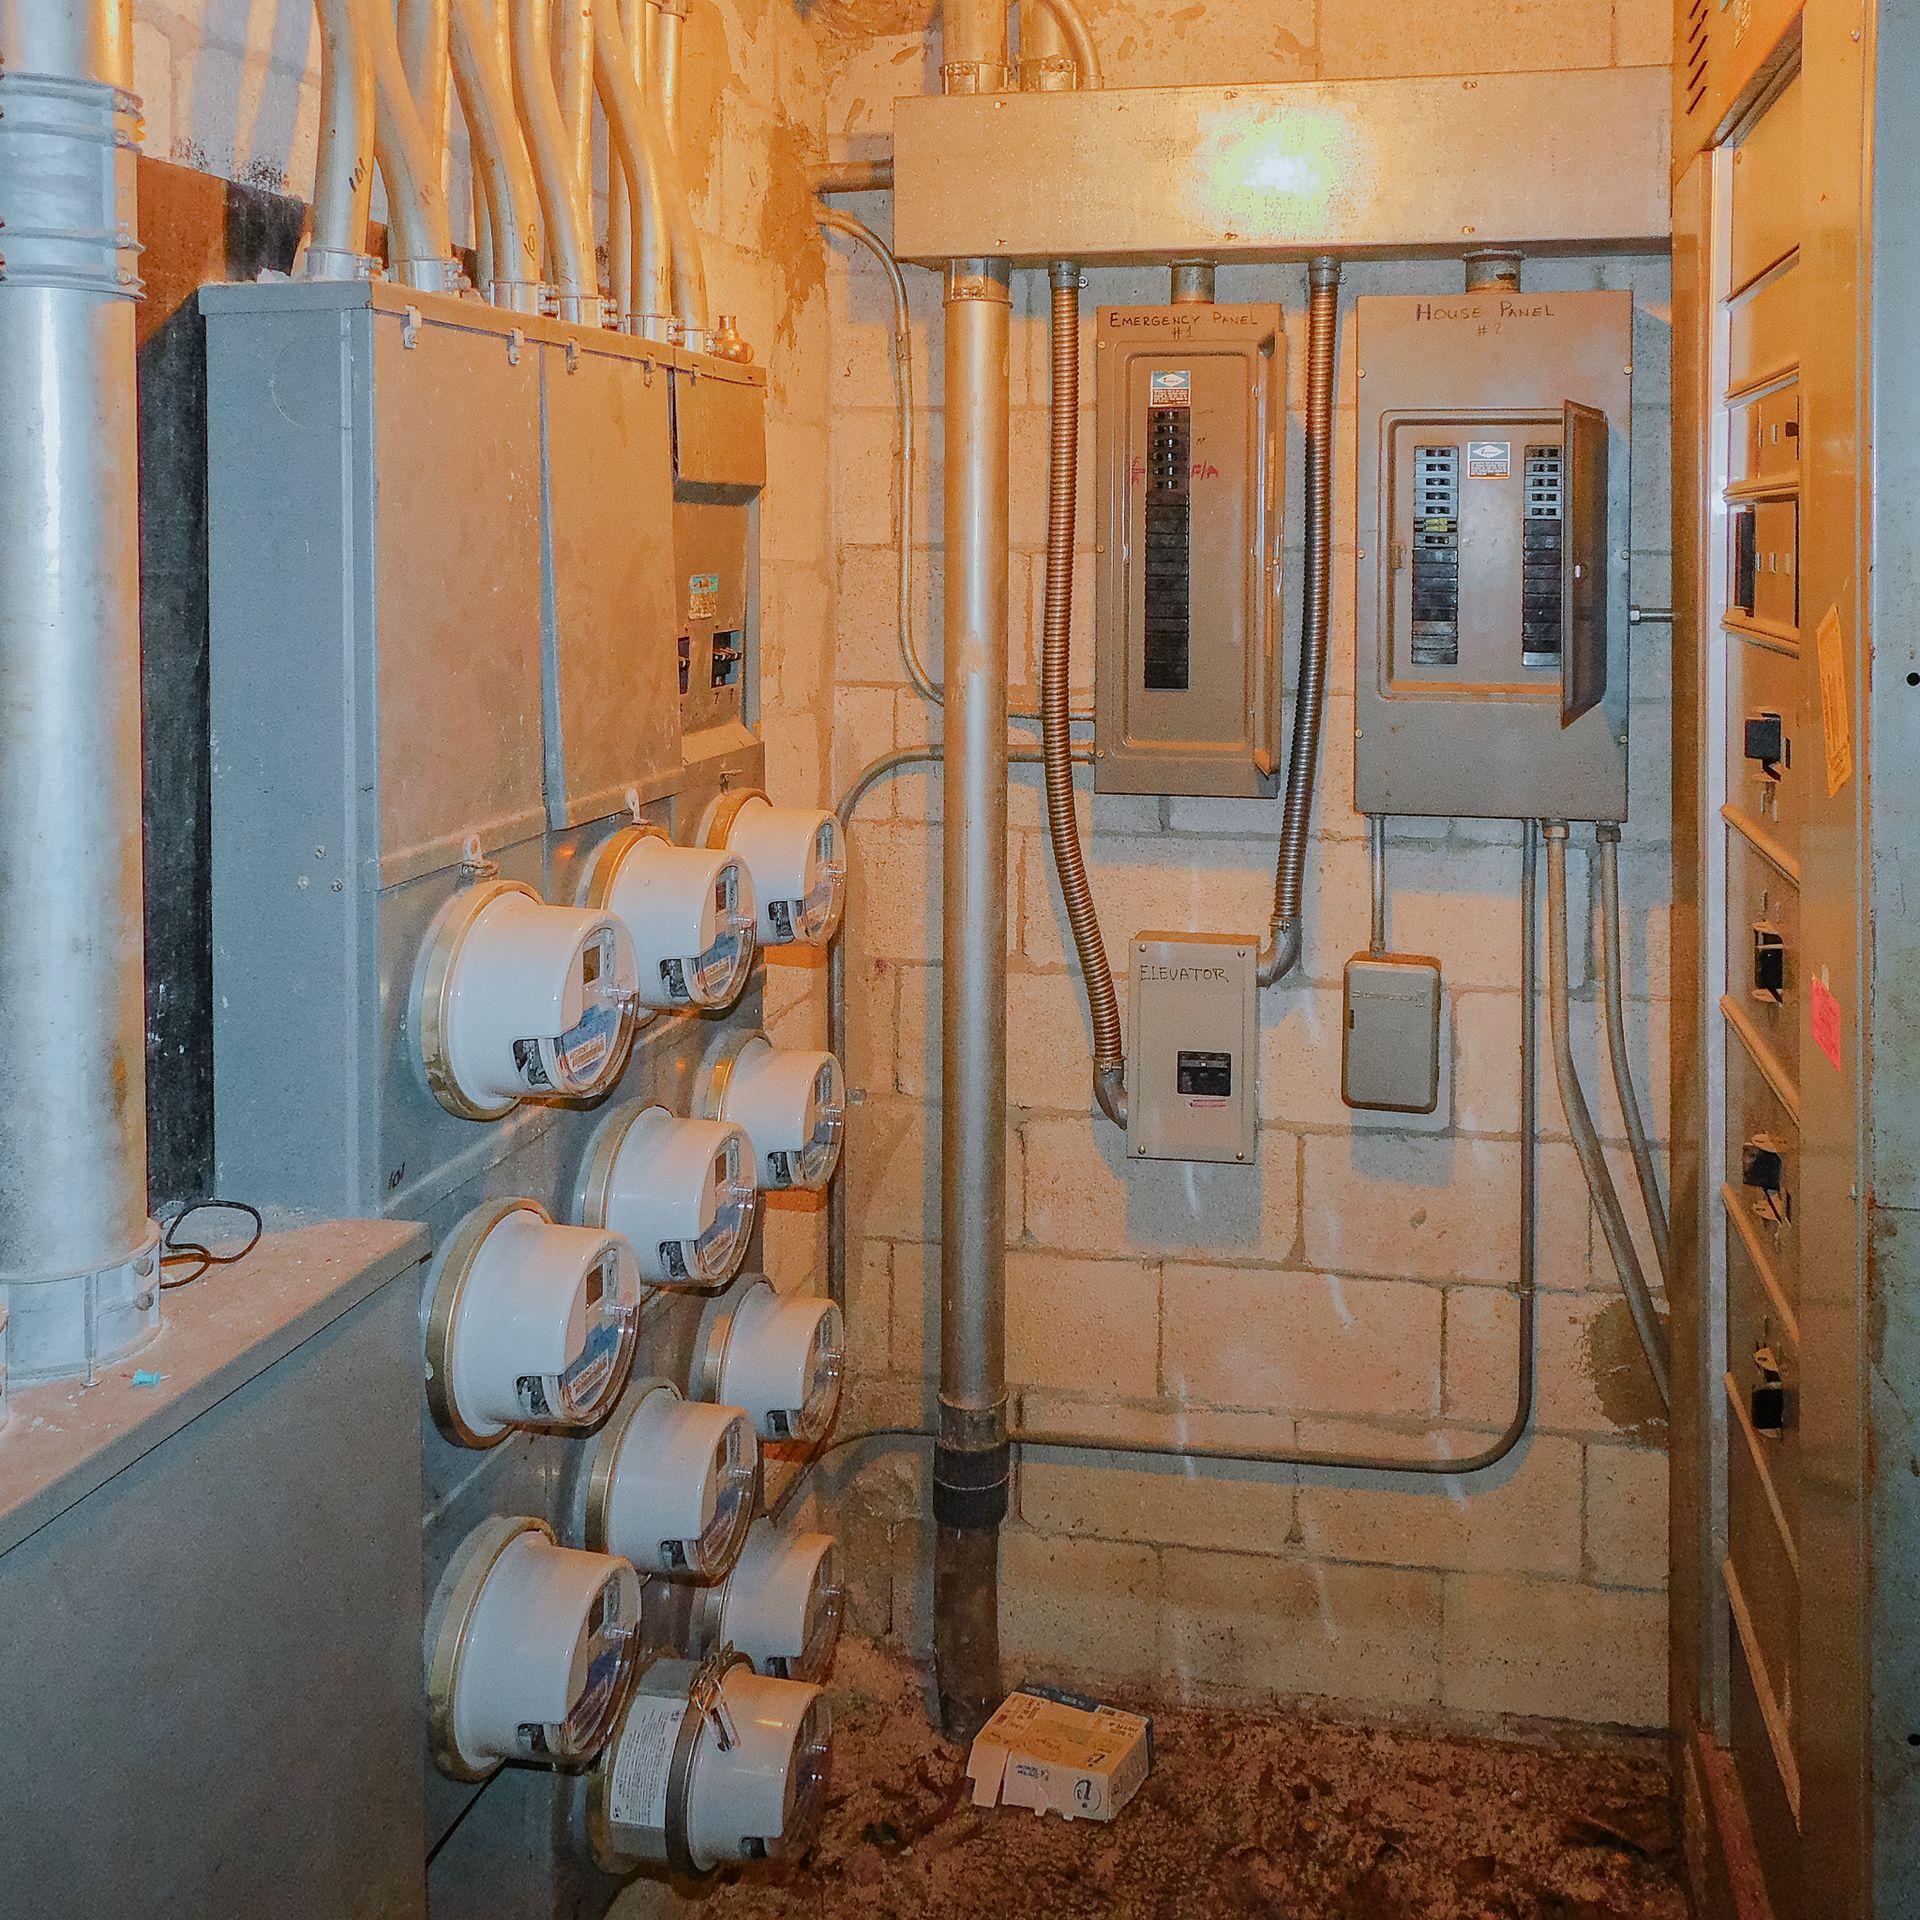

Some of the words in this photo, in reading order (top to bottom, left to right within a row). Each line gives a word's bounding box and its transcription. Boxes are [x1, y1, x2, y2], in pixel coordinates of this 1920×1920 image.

[1109, 311, 1201, 328] EMERGENCY
[1212, 311, 1259, 326] PANEL
[1415, 303, 1481, 321] HOUSE
[1500, 301, 1555, 318] PANEL
[1171, 327, 1194, 340] #1
[1139, 964, 1230, 983] ELEVATOR
